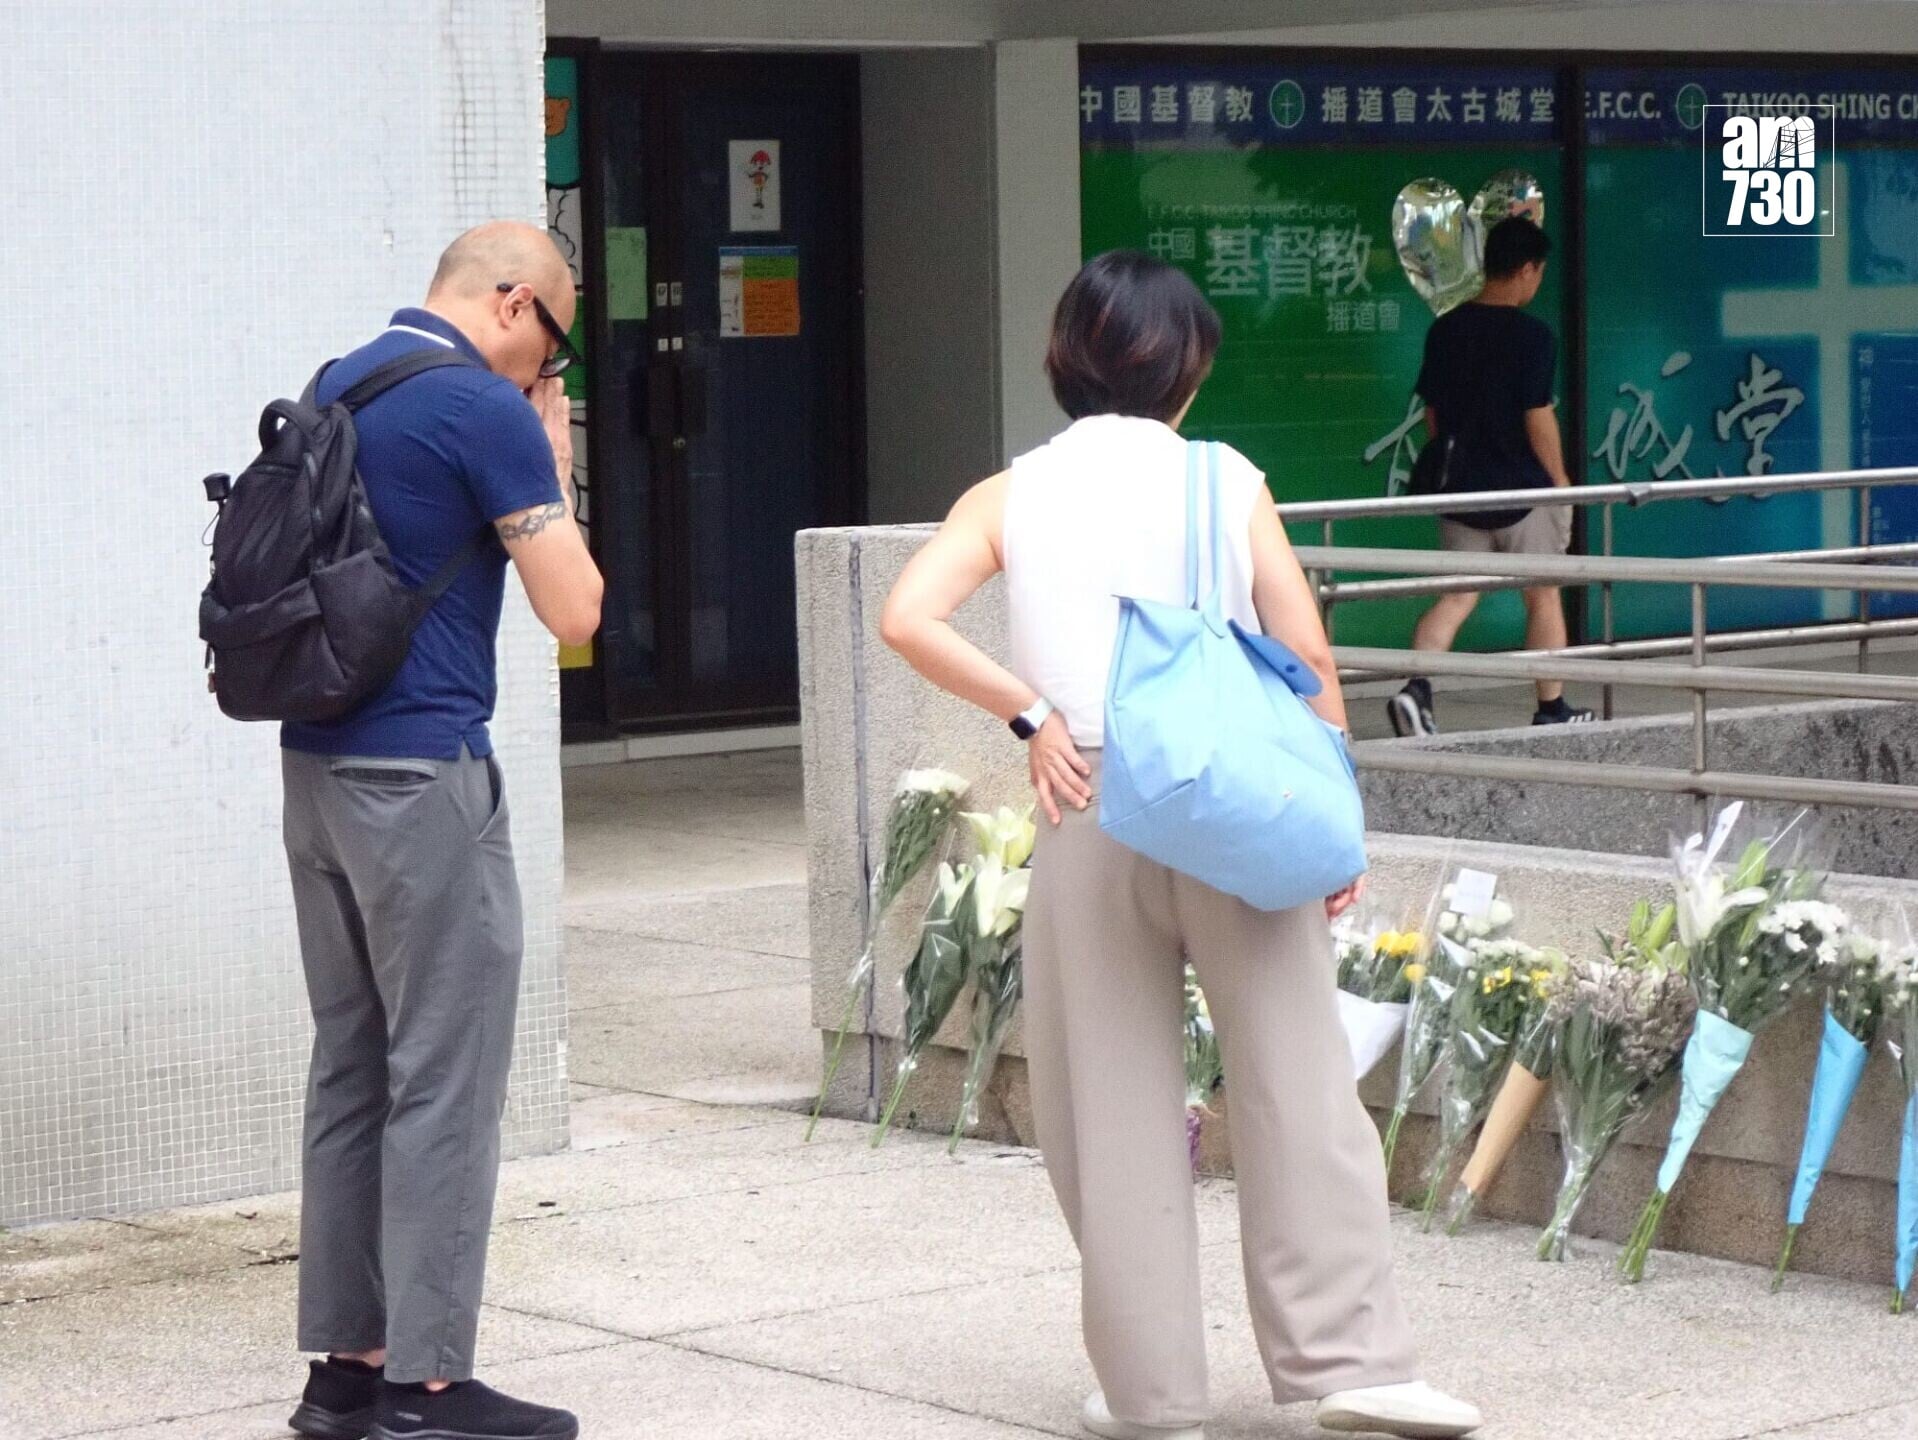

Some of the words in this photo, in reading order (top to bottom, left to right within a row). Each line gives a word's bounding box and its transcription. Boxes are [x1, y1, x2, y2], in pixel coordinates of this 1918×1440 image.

[1080, 85, 1253, 123] 中國基督教
[1321, 86, 1554, 123] 播道會太古城堂
[1722, 92, 1810, 118] TAIKOO
[1817, 93, 1891, 120] SHING
[1148, 227, 1195, 260] 中國
[1205, 223, 1373, 299] 基督教
